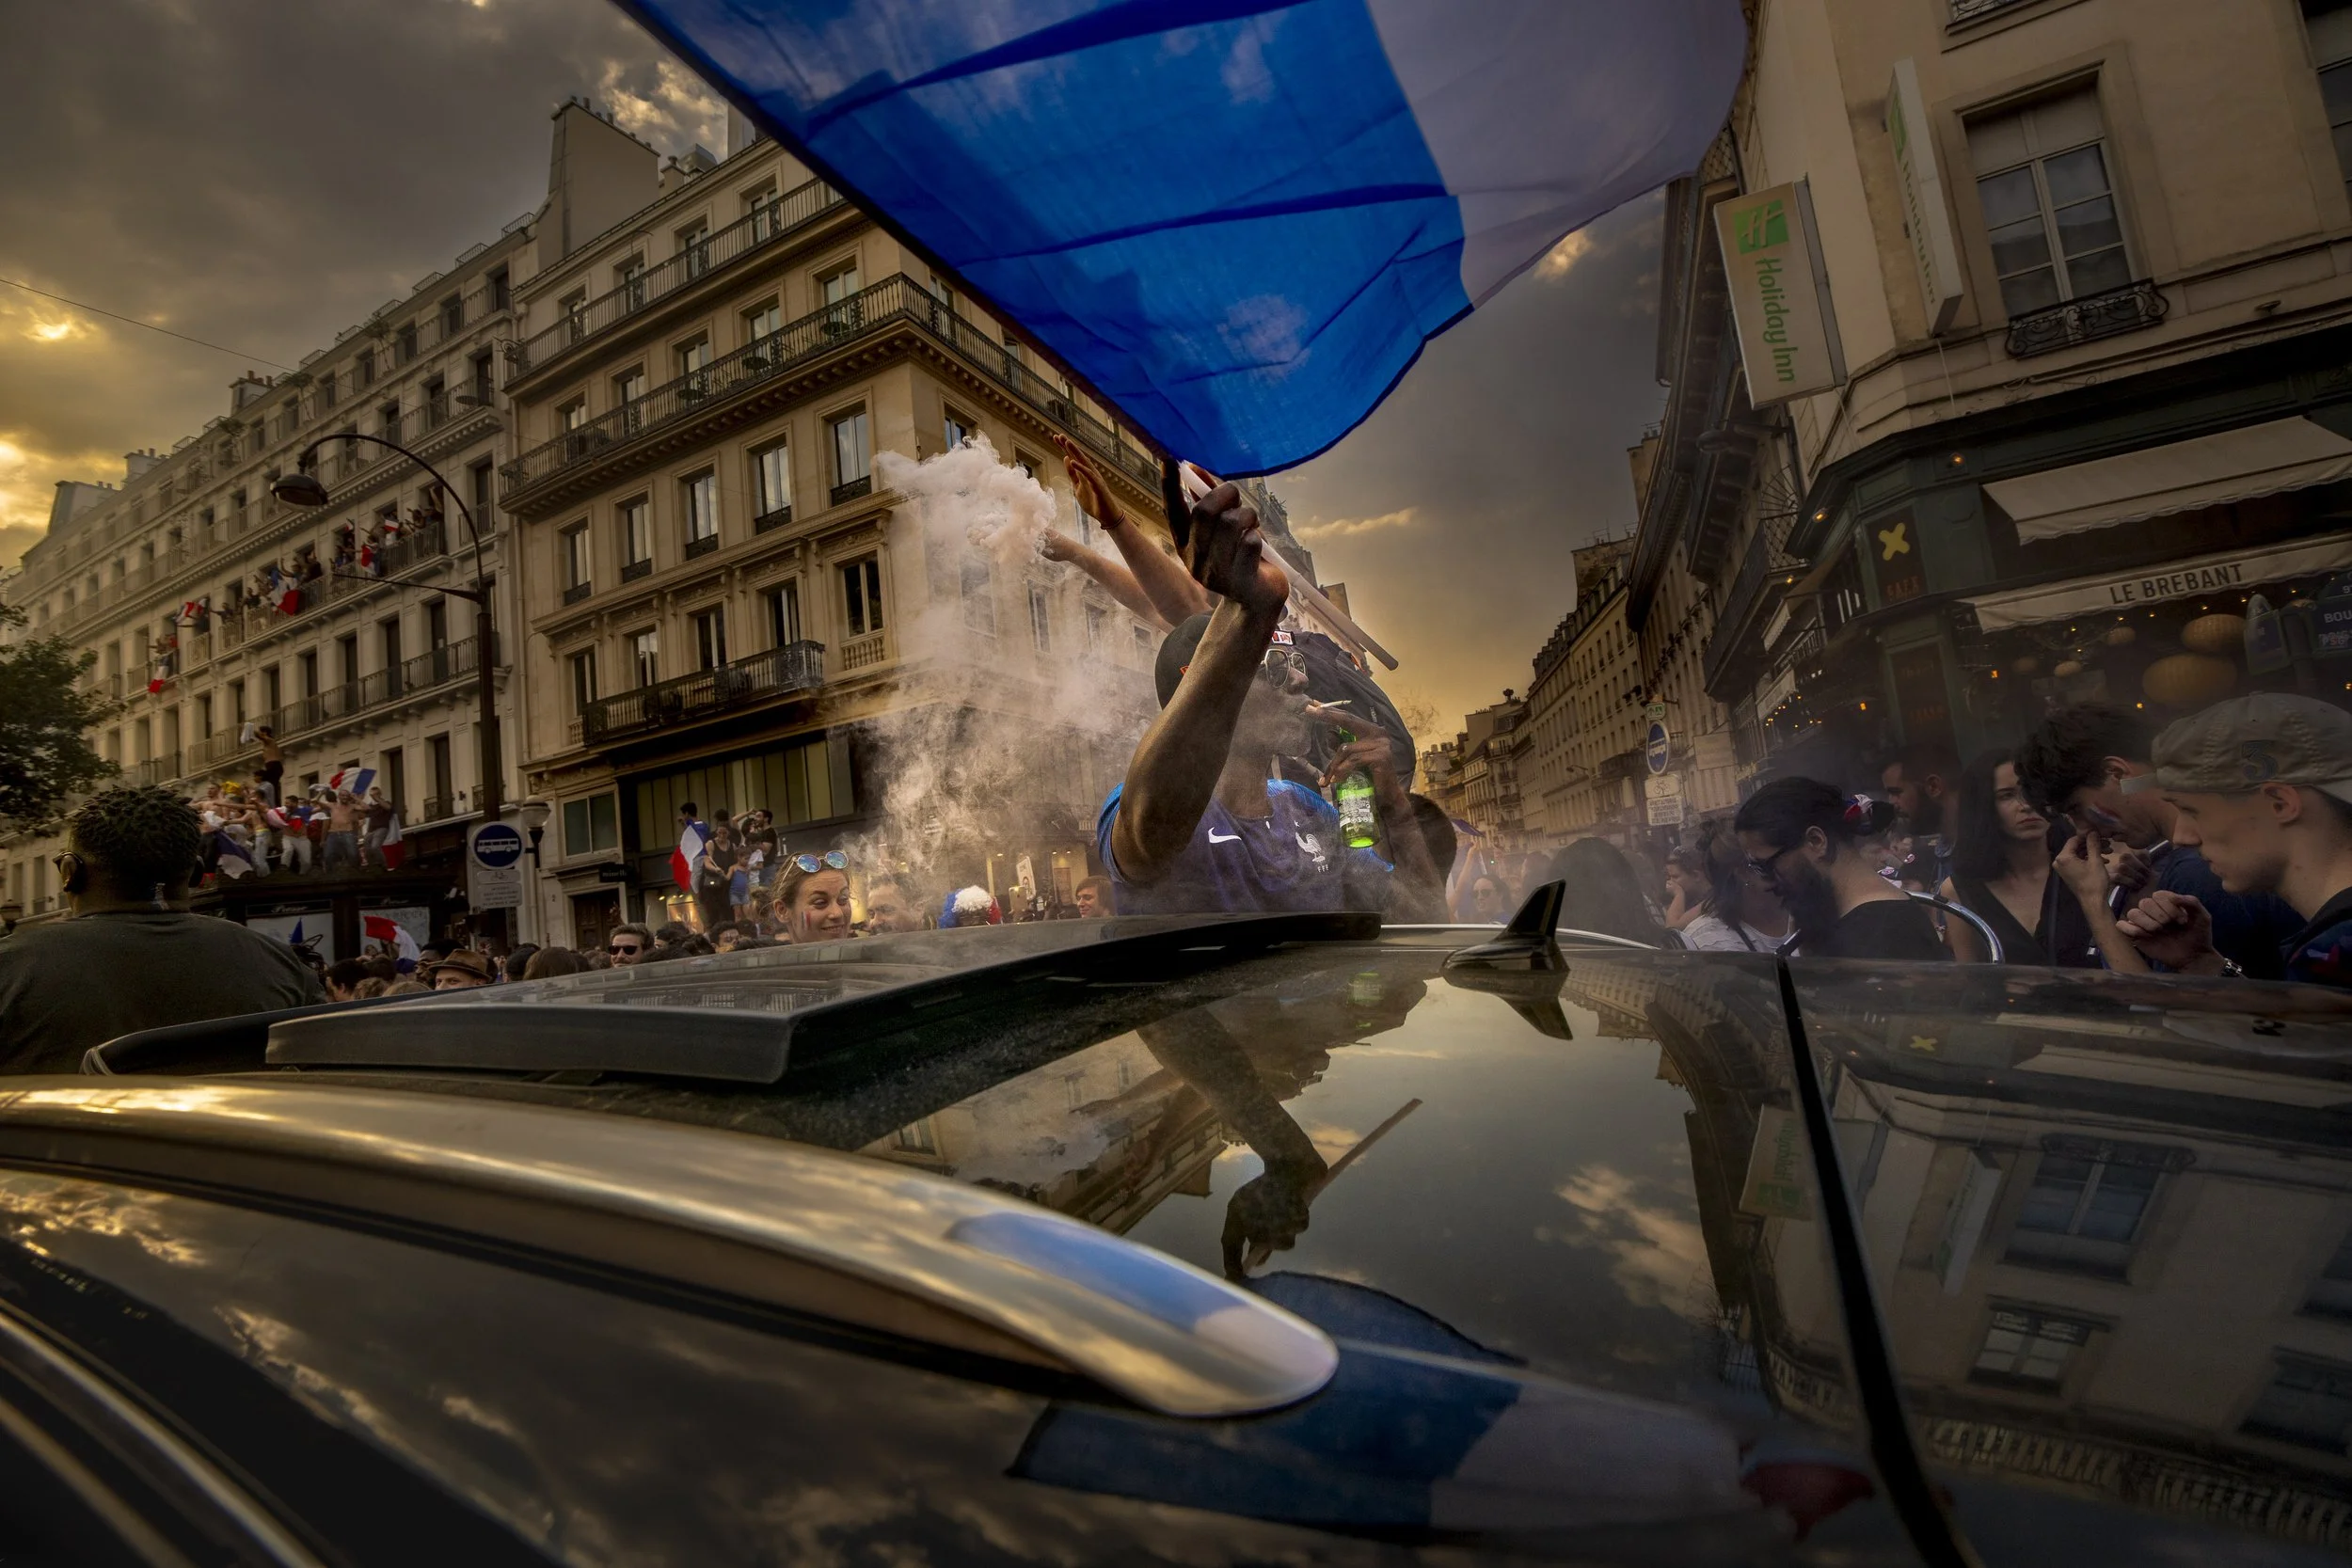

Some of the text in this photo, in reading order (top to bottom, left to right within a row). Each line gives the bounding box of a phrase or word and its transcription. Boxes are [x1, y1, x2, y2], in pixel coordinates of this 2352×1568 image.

[1902, 161, 1926, 262] Holiday
[1755, 257, 1799, 383] Holiday Inn
[2109, 563, 2242, 604] LE BREBANT
[2242, 739, 2279, 781] 3
